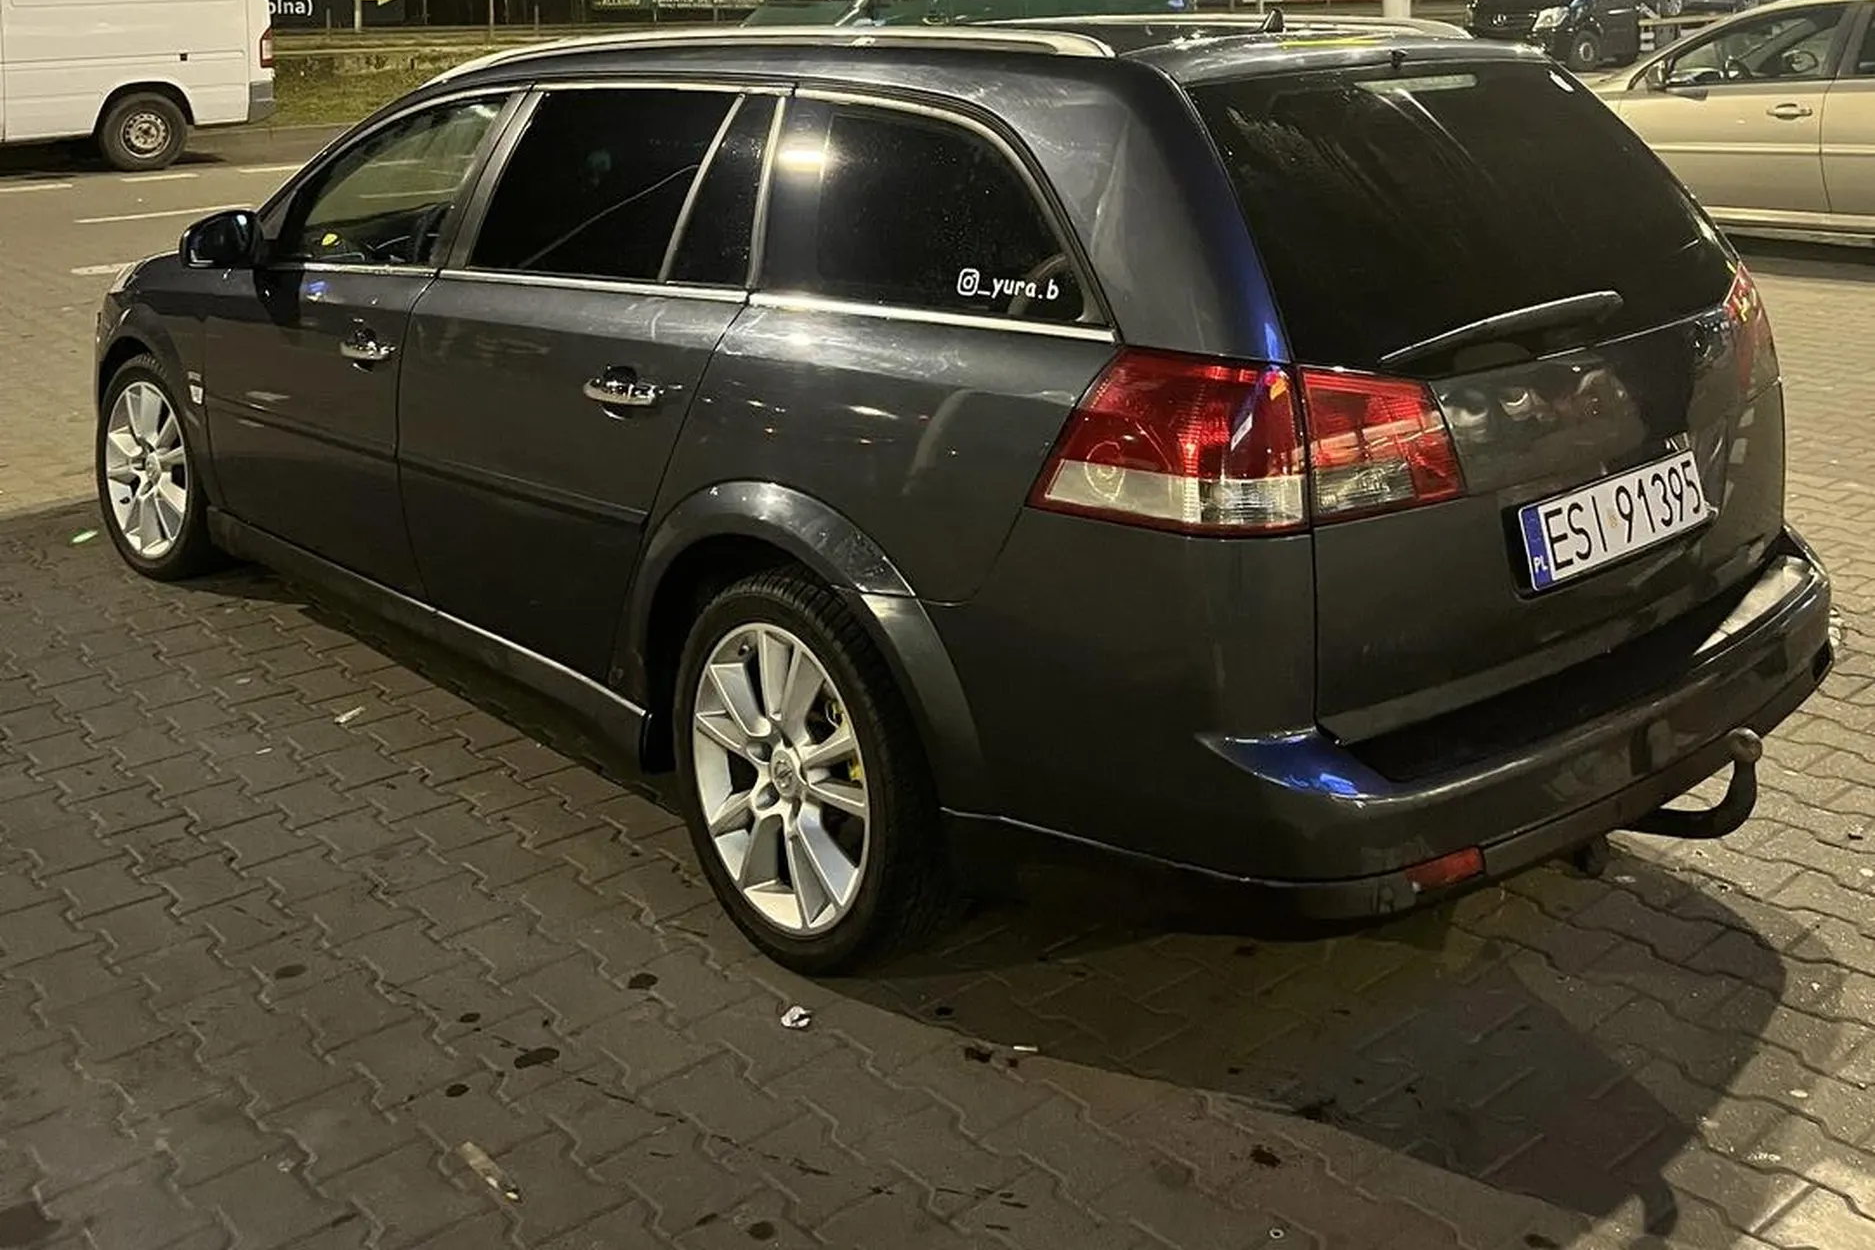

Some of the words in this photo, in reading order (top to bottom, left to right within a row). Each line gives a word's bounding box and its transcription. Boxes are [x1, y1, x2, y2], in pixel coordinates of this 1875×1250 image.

[1543, 494, 1608, 572] ESI
[1614, 460, 1702, 544] 91395
[1532, 556, 1549, 573] PL
